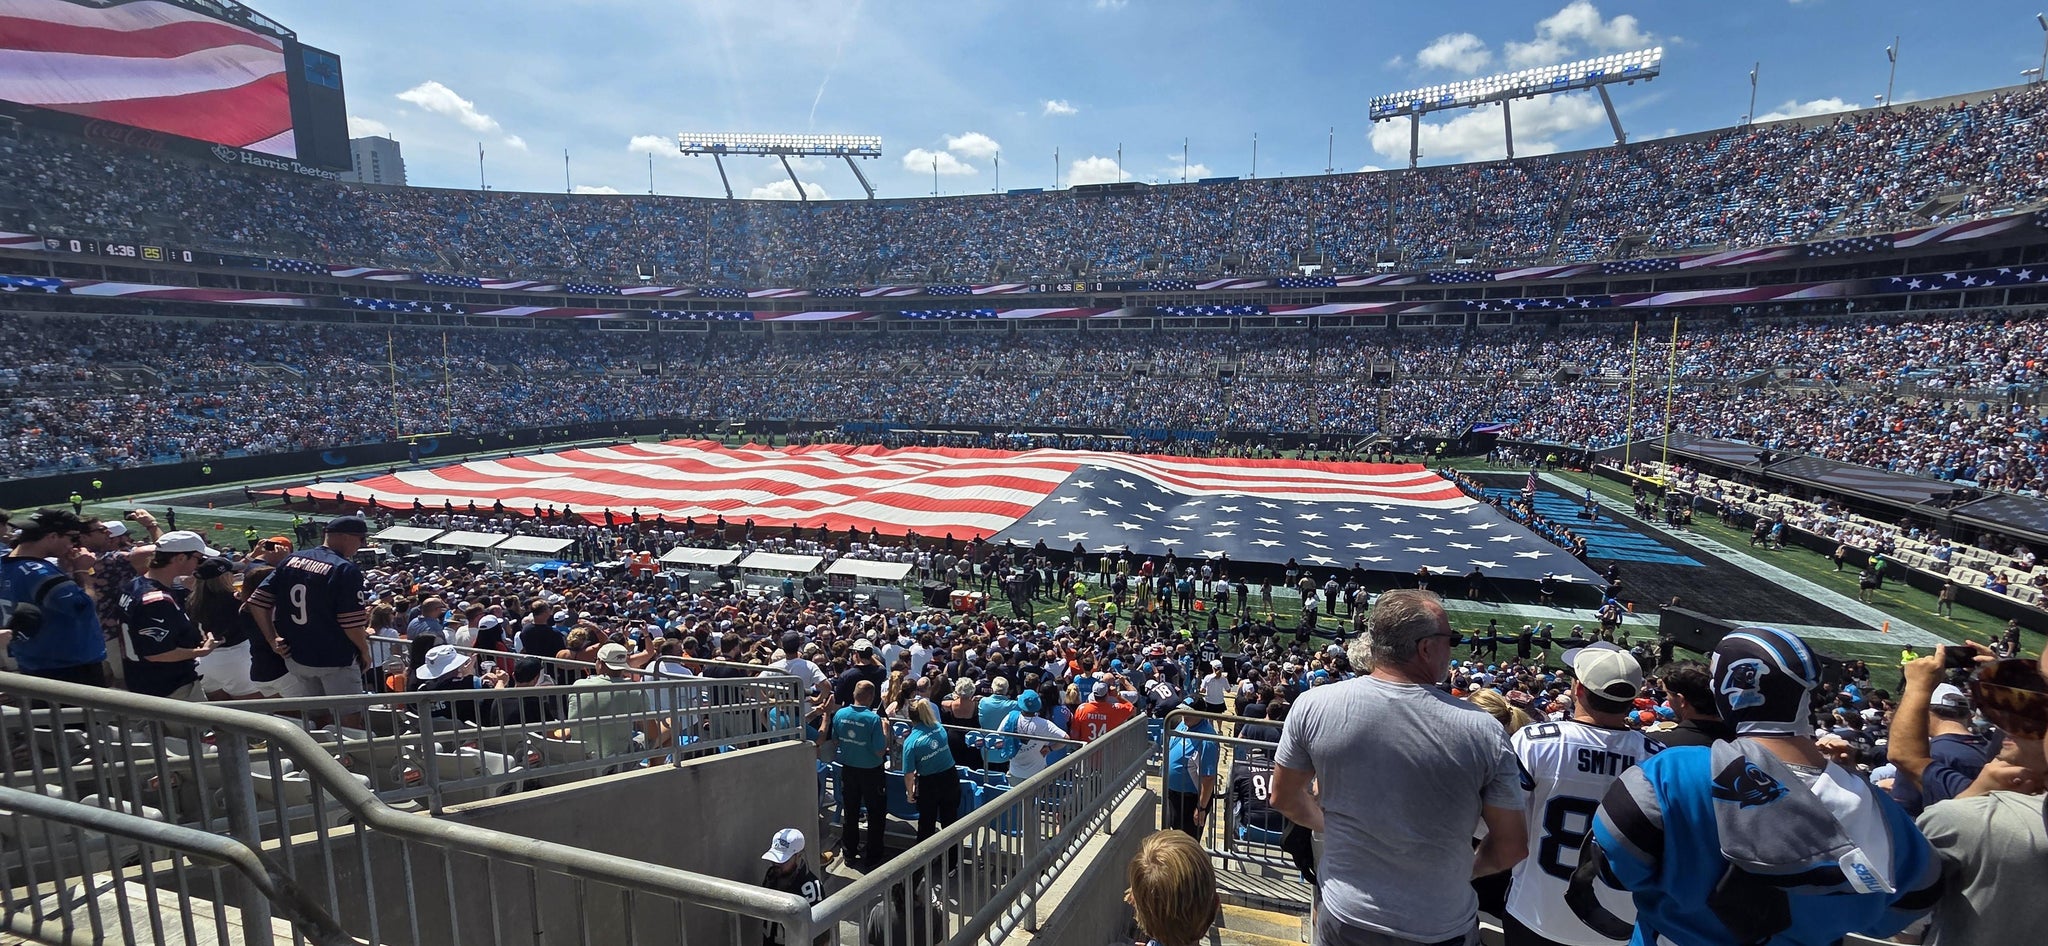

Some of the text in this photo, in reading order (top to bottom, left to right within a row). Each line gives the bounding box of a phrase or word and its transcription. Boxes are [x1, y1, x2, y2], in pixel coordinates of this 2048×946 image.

[240, 151, 337, 182] Harris Teeter
[69, 239, 82, 252] 0
[106, 244, 136, 257] 4:36
[143, 247, 160, 259] 25
[183, 250, 193, 262] 0
[290, 583, 309, 625] 9
[356, 590, 366, 605] 9
[1201, 651, 1215, 662] 90
[1155, 684, 1173, 700] 18
[1087, 713, 1107, 721] PAYTON
[1087, 722, 1107, 740] 34
[801, 880, 823, 903] 91
